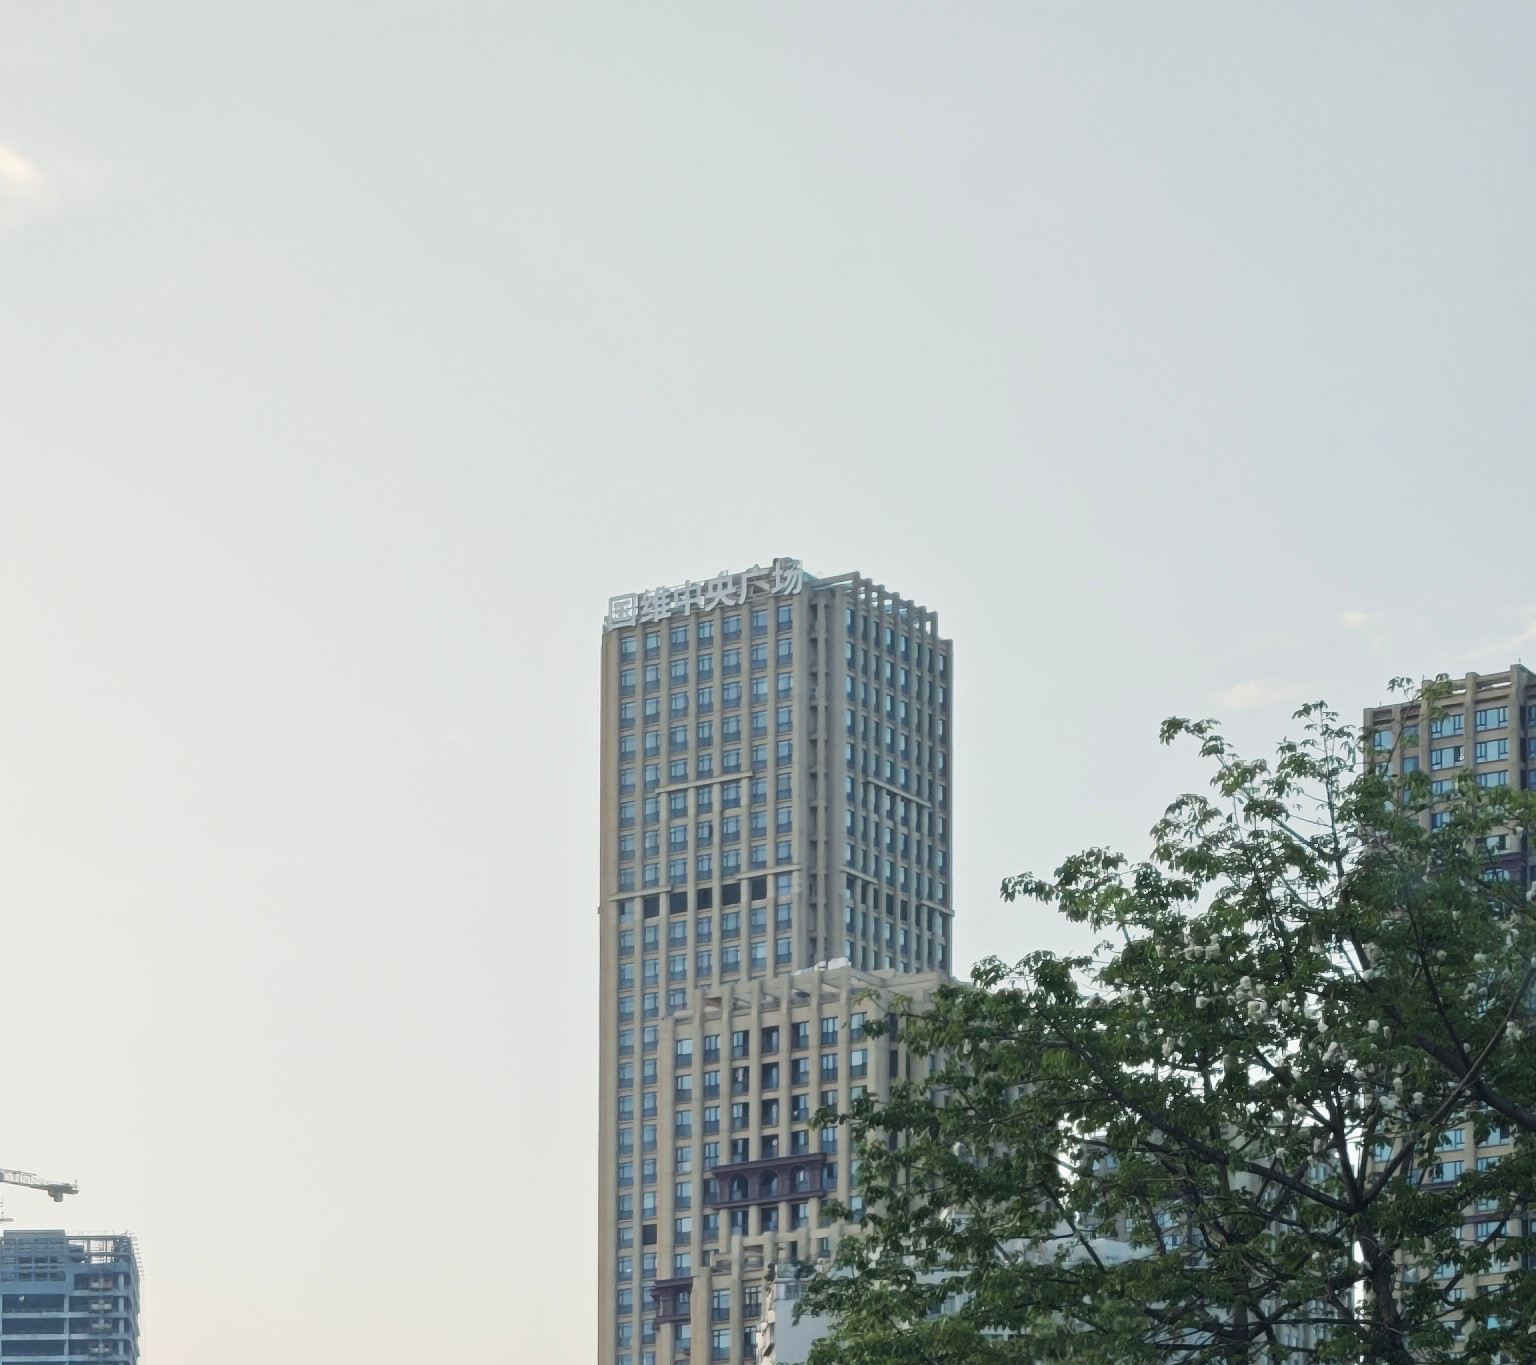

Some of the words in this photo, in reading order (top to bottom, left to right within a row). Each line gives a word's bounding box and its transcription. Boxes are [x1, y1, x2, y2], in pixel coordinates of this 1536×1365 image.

[608, 560, 804, 628] 国维中央广场
